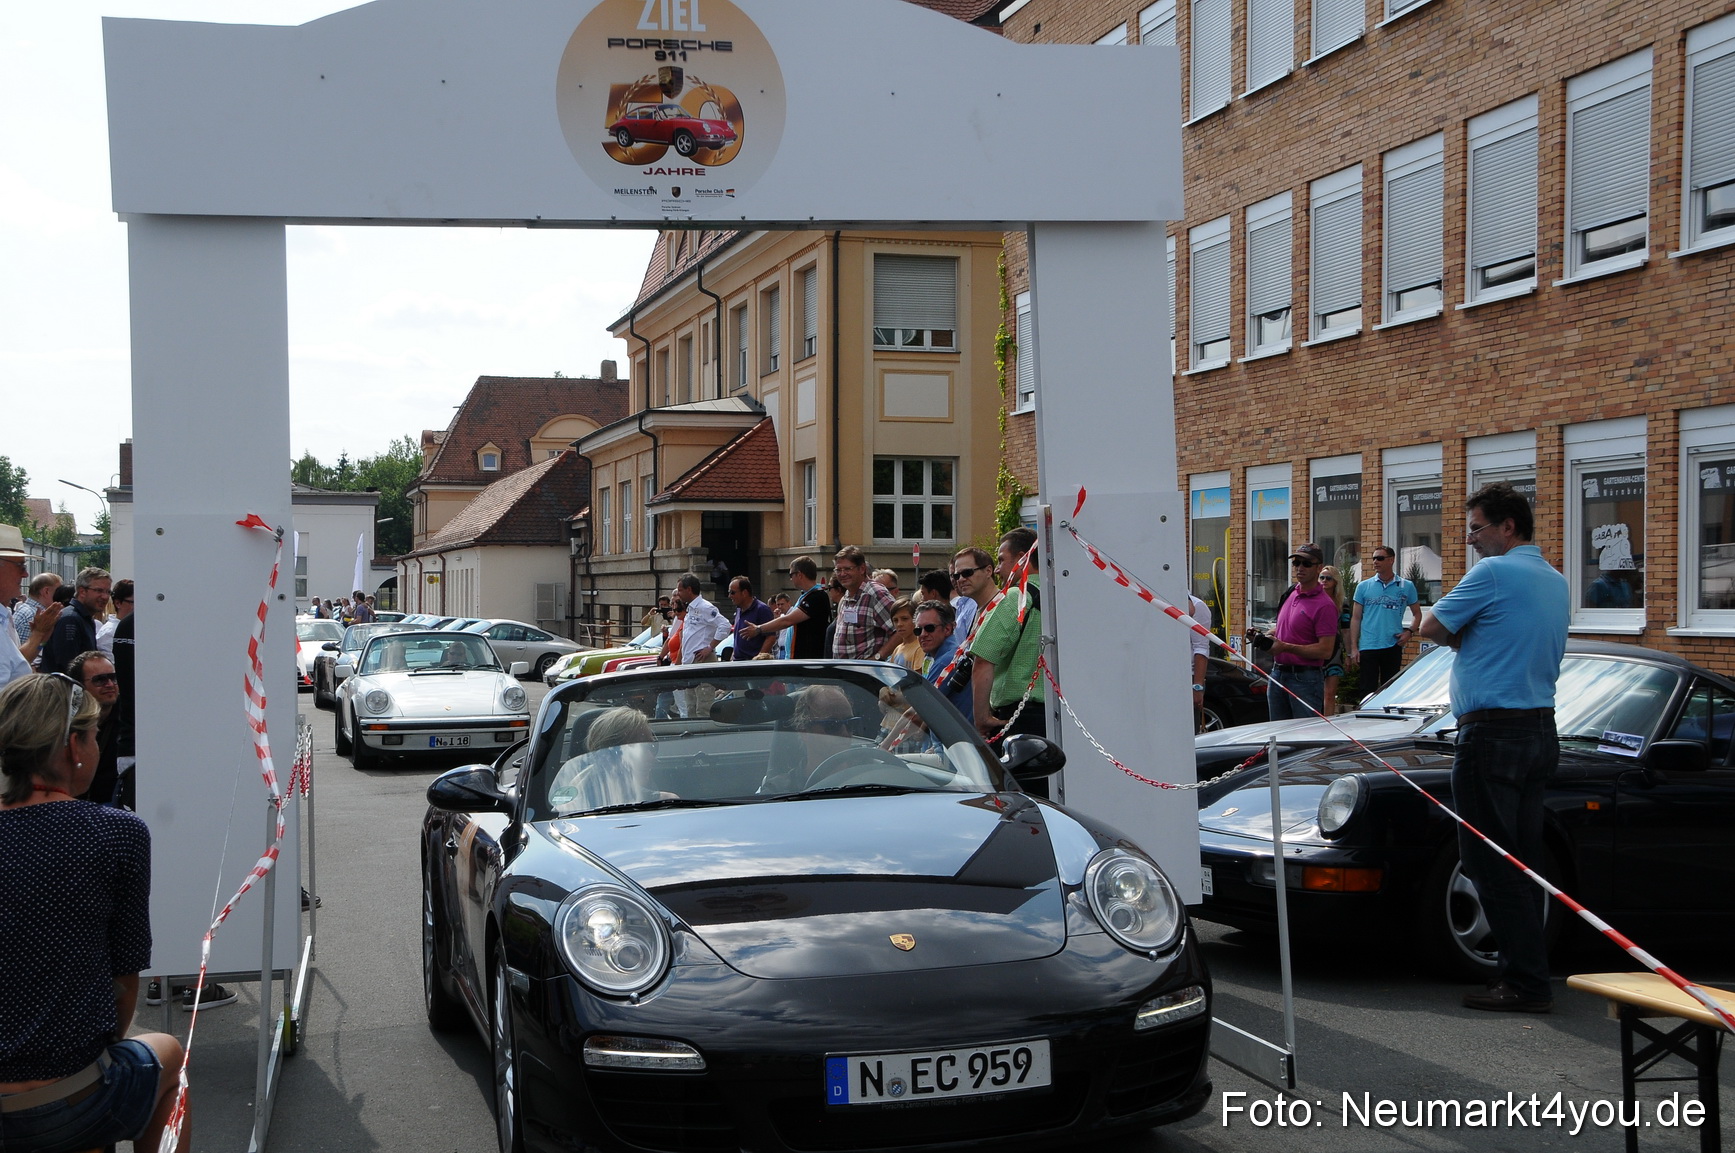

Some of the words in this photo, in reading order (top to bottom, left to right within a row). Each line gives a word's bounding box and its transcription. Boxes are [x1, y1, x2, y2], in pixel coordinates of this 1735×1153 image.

[636, 0, 706, 32] ZIEL
[607, 38, 733, 51] PORSCHE
[654, 50, 688, 62] 911
[601, 84, 745, 167] 50
[642, 167, 706, 176] JAHRE
[613, 187, 658, 195] MEILENSTEIN
[860, 1060, 884, 1098] N
[911, 1054, 959, 1095] EC
[967, 1046, 1033, 1089] 959
[833, 1085, 842, 1096] D
